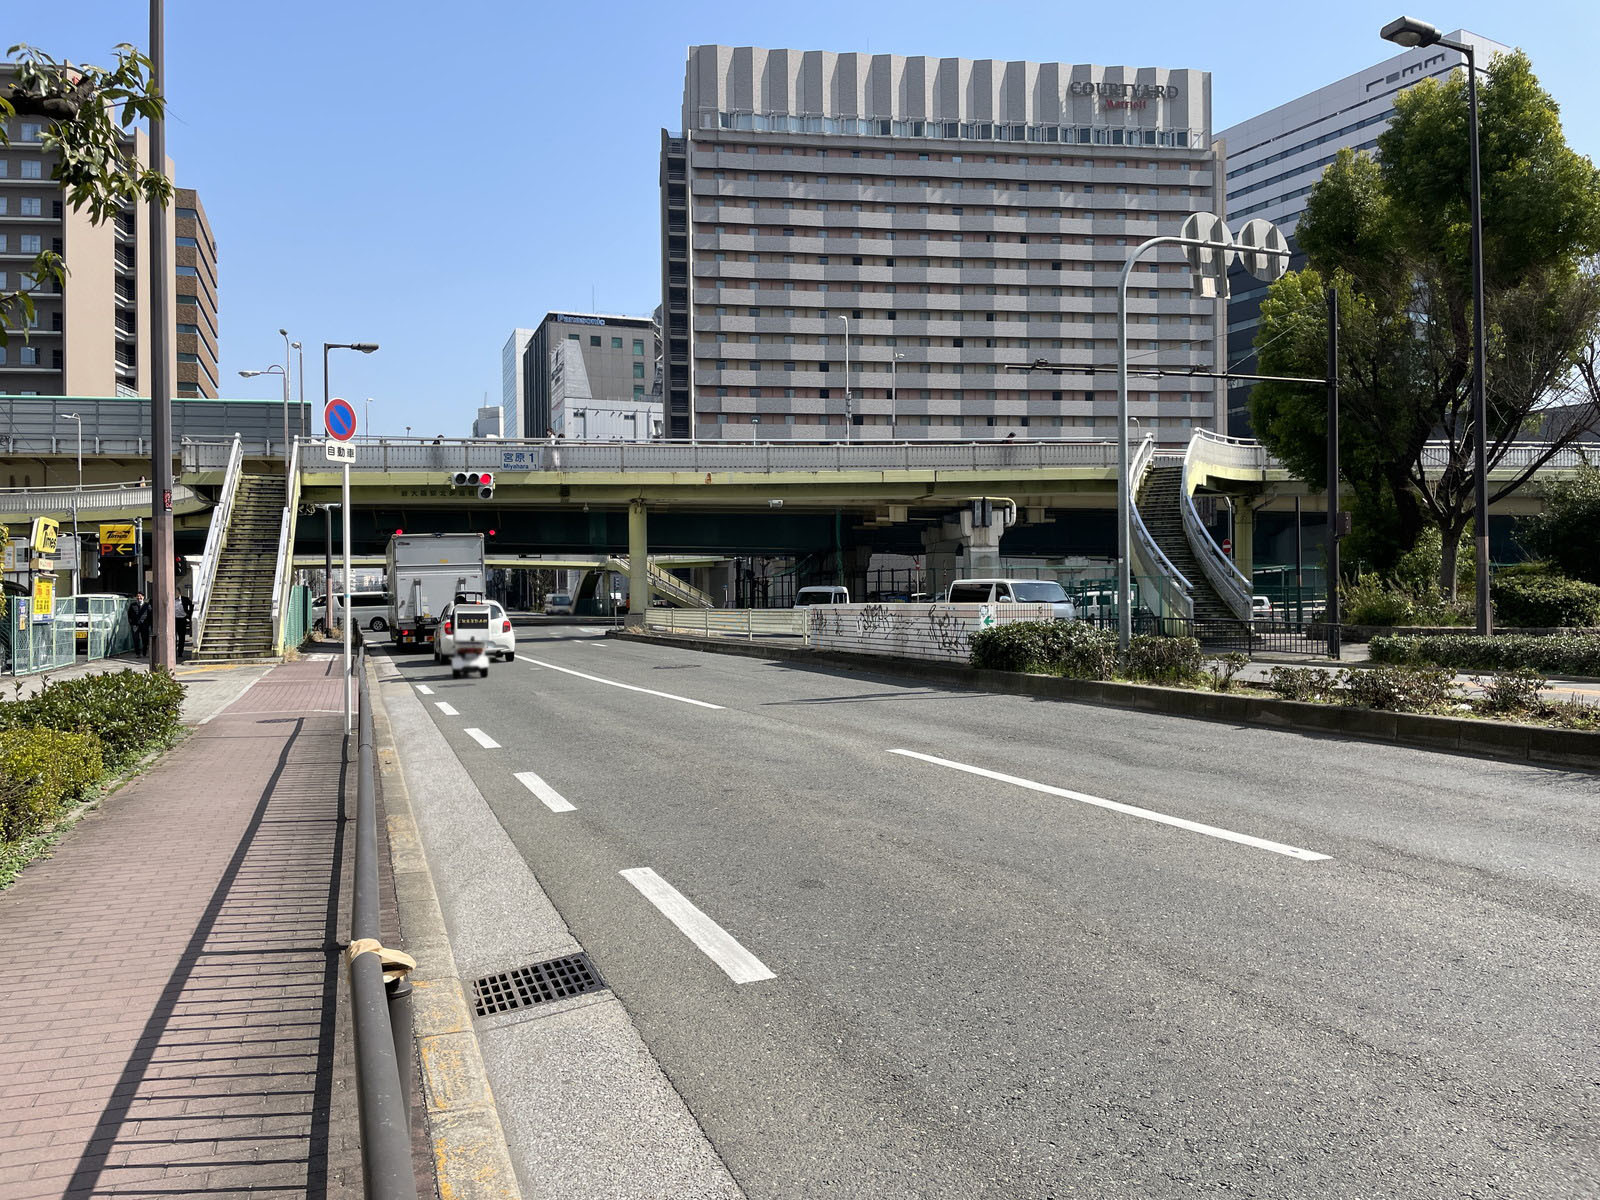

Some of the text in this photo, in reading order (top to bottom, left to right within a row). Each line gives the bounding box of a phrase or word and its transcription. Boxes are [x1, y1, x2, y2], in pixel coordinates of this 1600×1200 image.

[1070, 81, 1179, 99] COURTYARD
[1105, 99, 1147, 110] Marriott
[557, 313, 606, 327] Panasonic
[327, 445, 355, 458] 自動車
[503, 452, 526, 463] 宮原
[106, 530, 131, 540] Times
[101, 543, 113, 556] P
